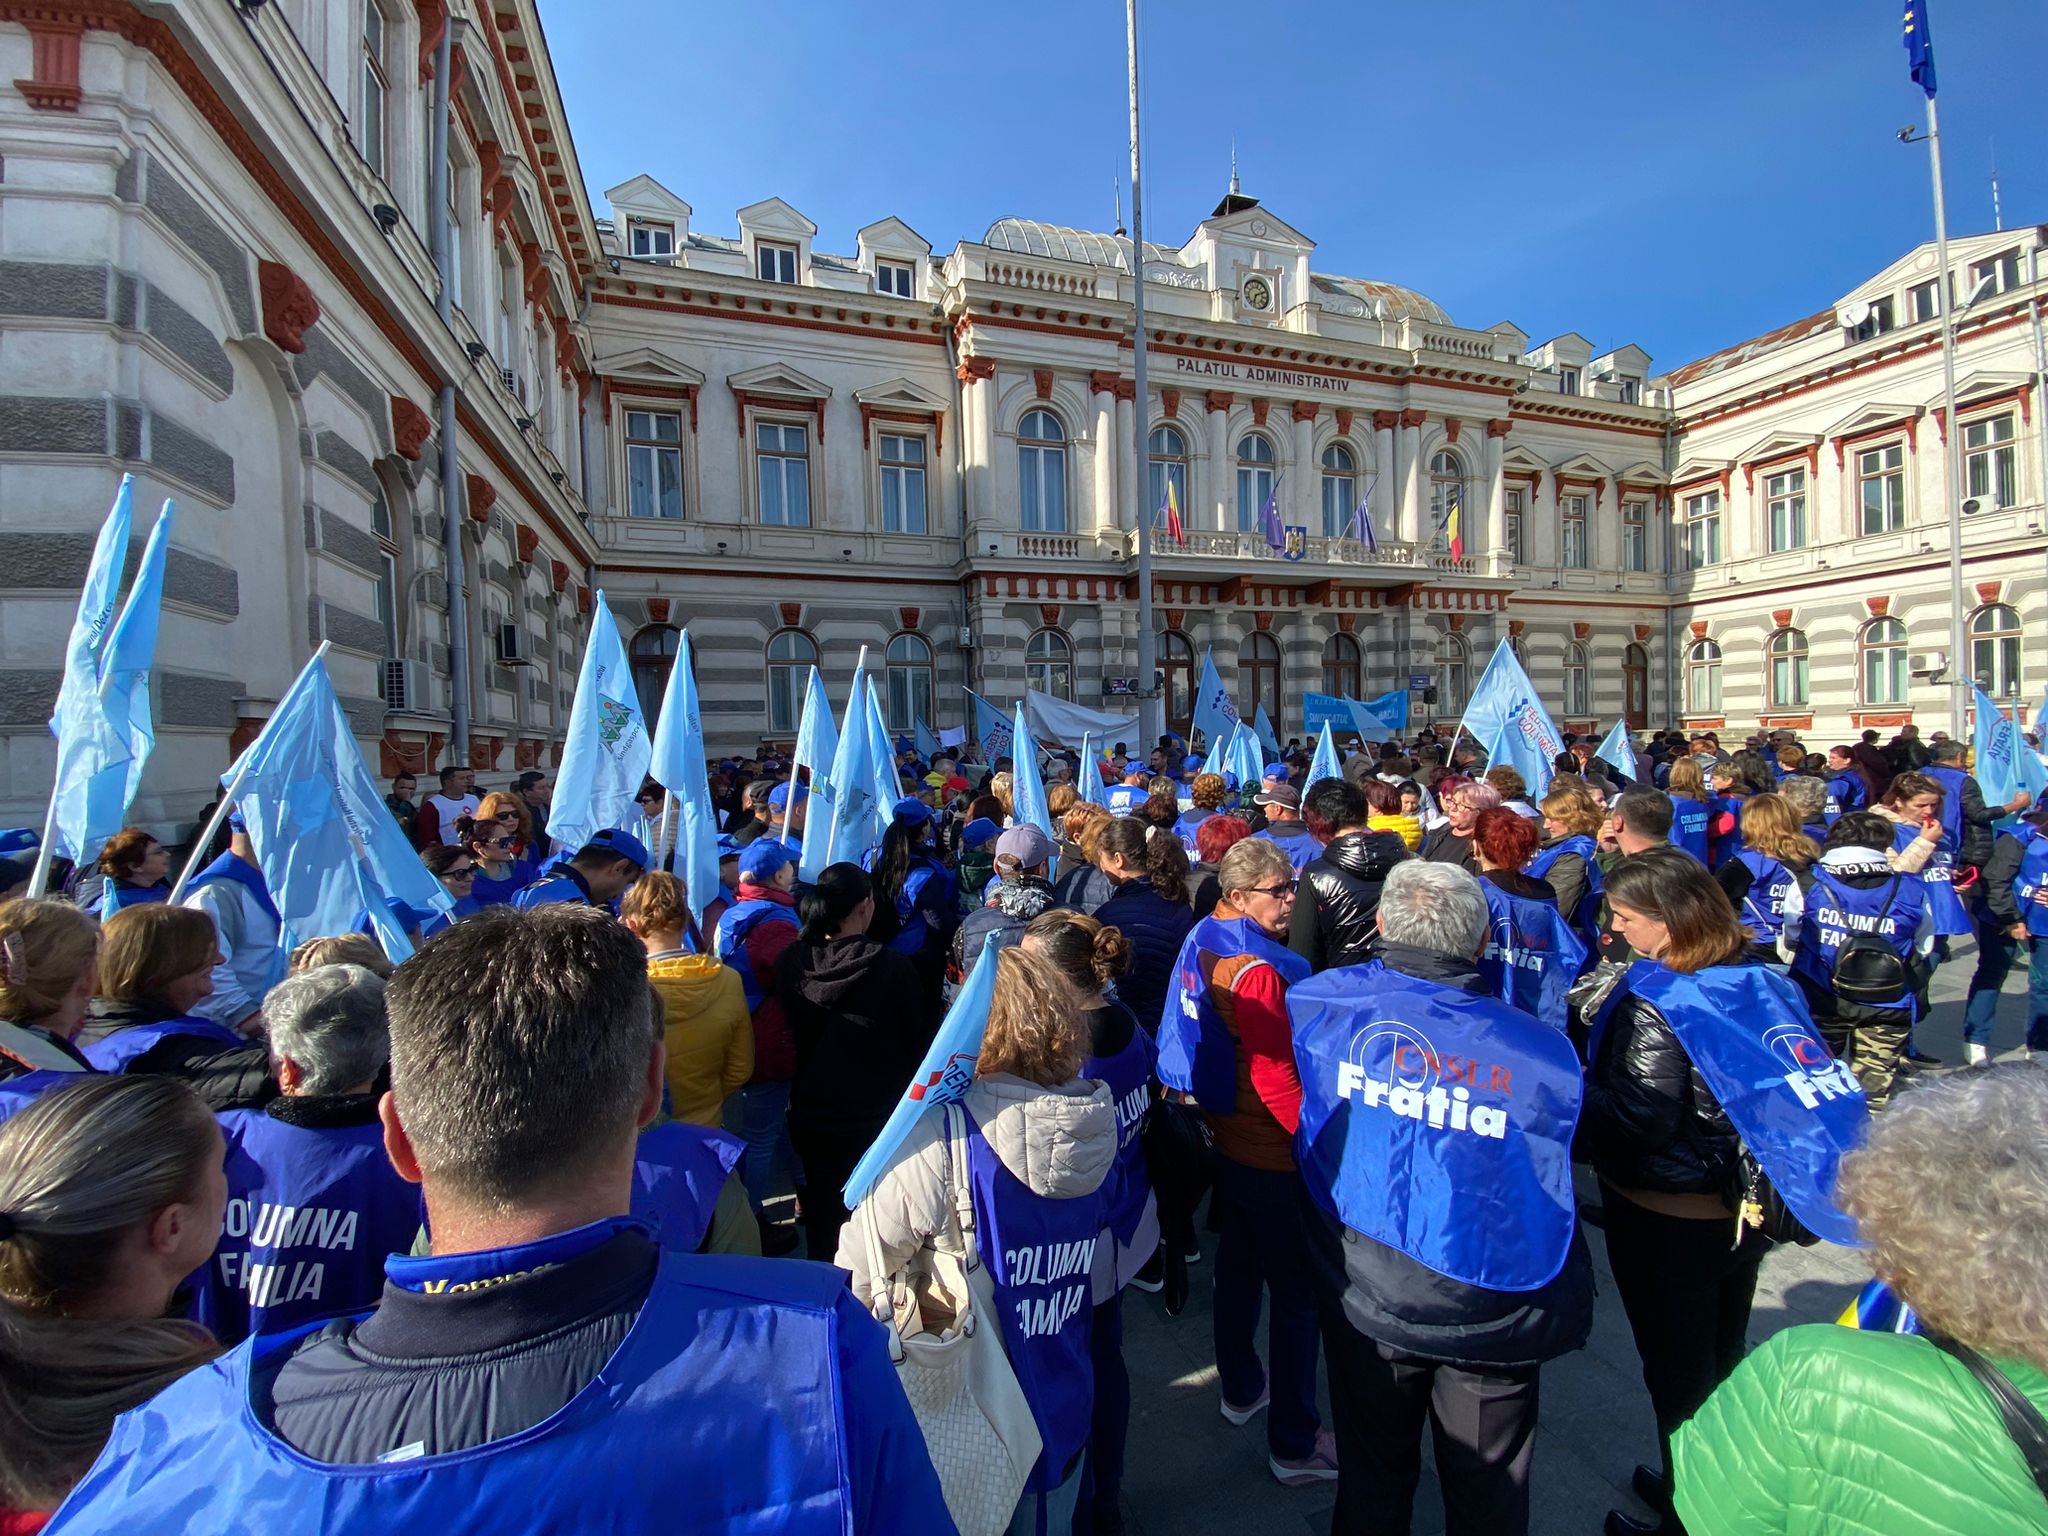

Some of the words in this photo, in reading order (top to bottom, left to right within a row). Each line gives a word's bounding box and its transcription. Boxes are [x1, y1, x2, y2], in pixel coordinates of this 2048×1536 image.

[1176, 358, 1239, 378] PALATUL
[1246, 368, 1350, 392] ADMINISTRATIV
[1396, 1045, 1513, 1096] CNSLR
